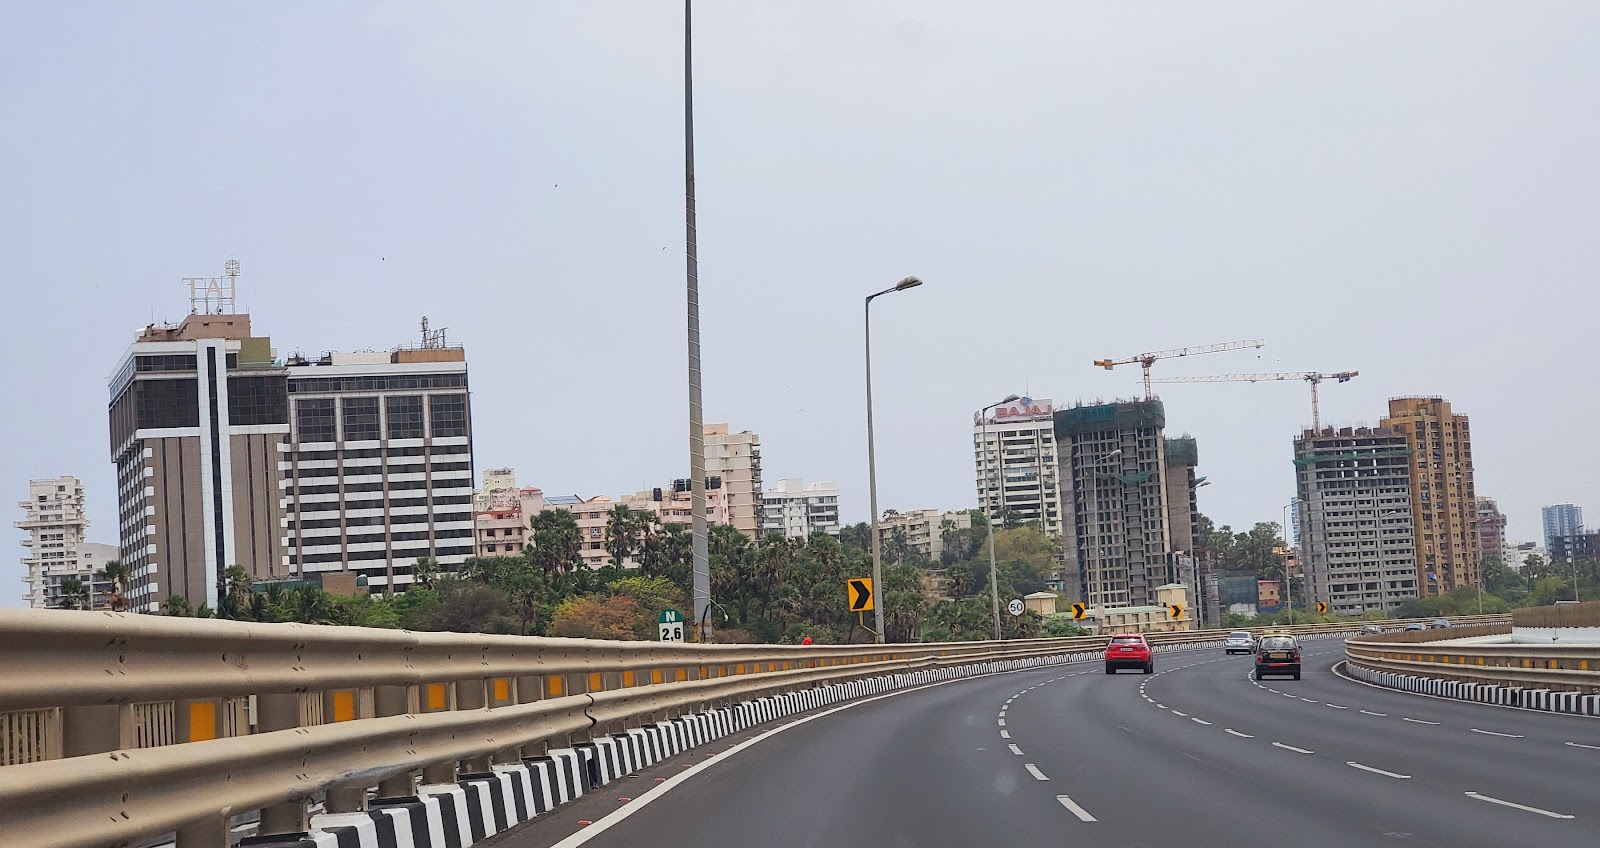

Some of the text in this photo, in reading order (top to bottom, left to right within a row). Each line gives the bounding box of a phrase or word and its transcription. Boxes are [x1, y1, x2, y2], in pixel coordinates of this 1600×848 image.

[182, 277, 235, 304] TAJ
[996, 405, 1051, 418] BAJAJ
[1010, 602, 1023, 612] 50
[665, 610, 676, 622] N
[662, 627, 682, 642] 2,6
